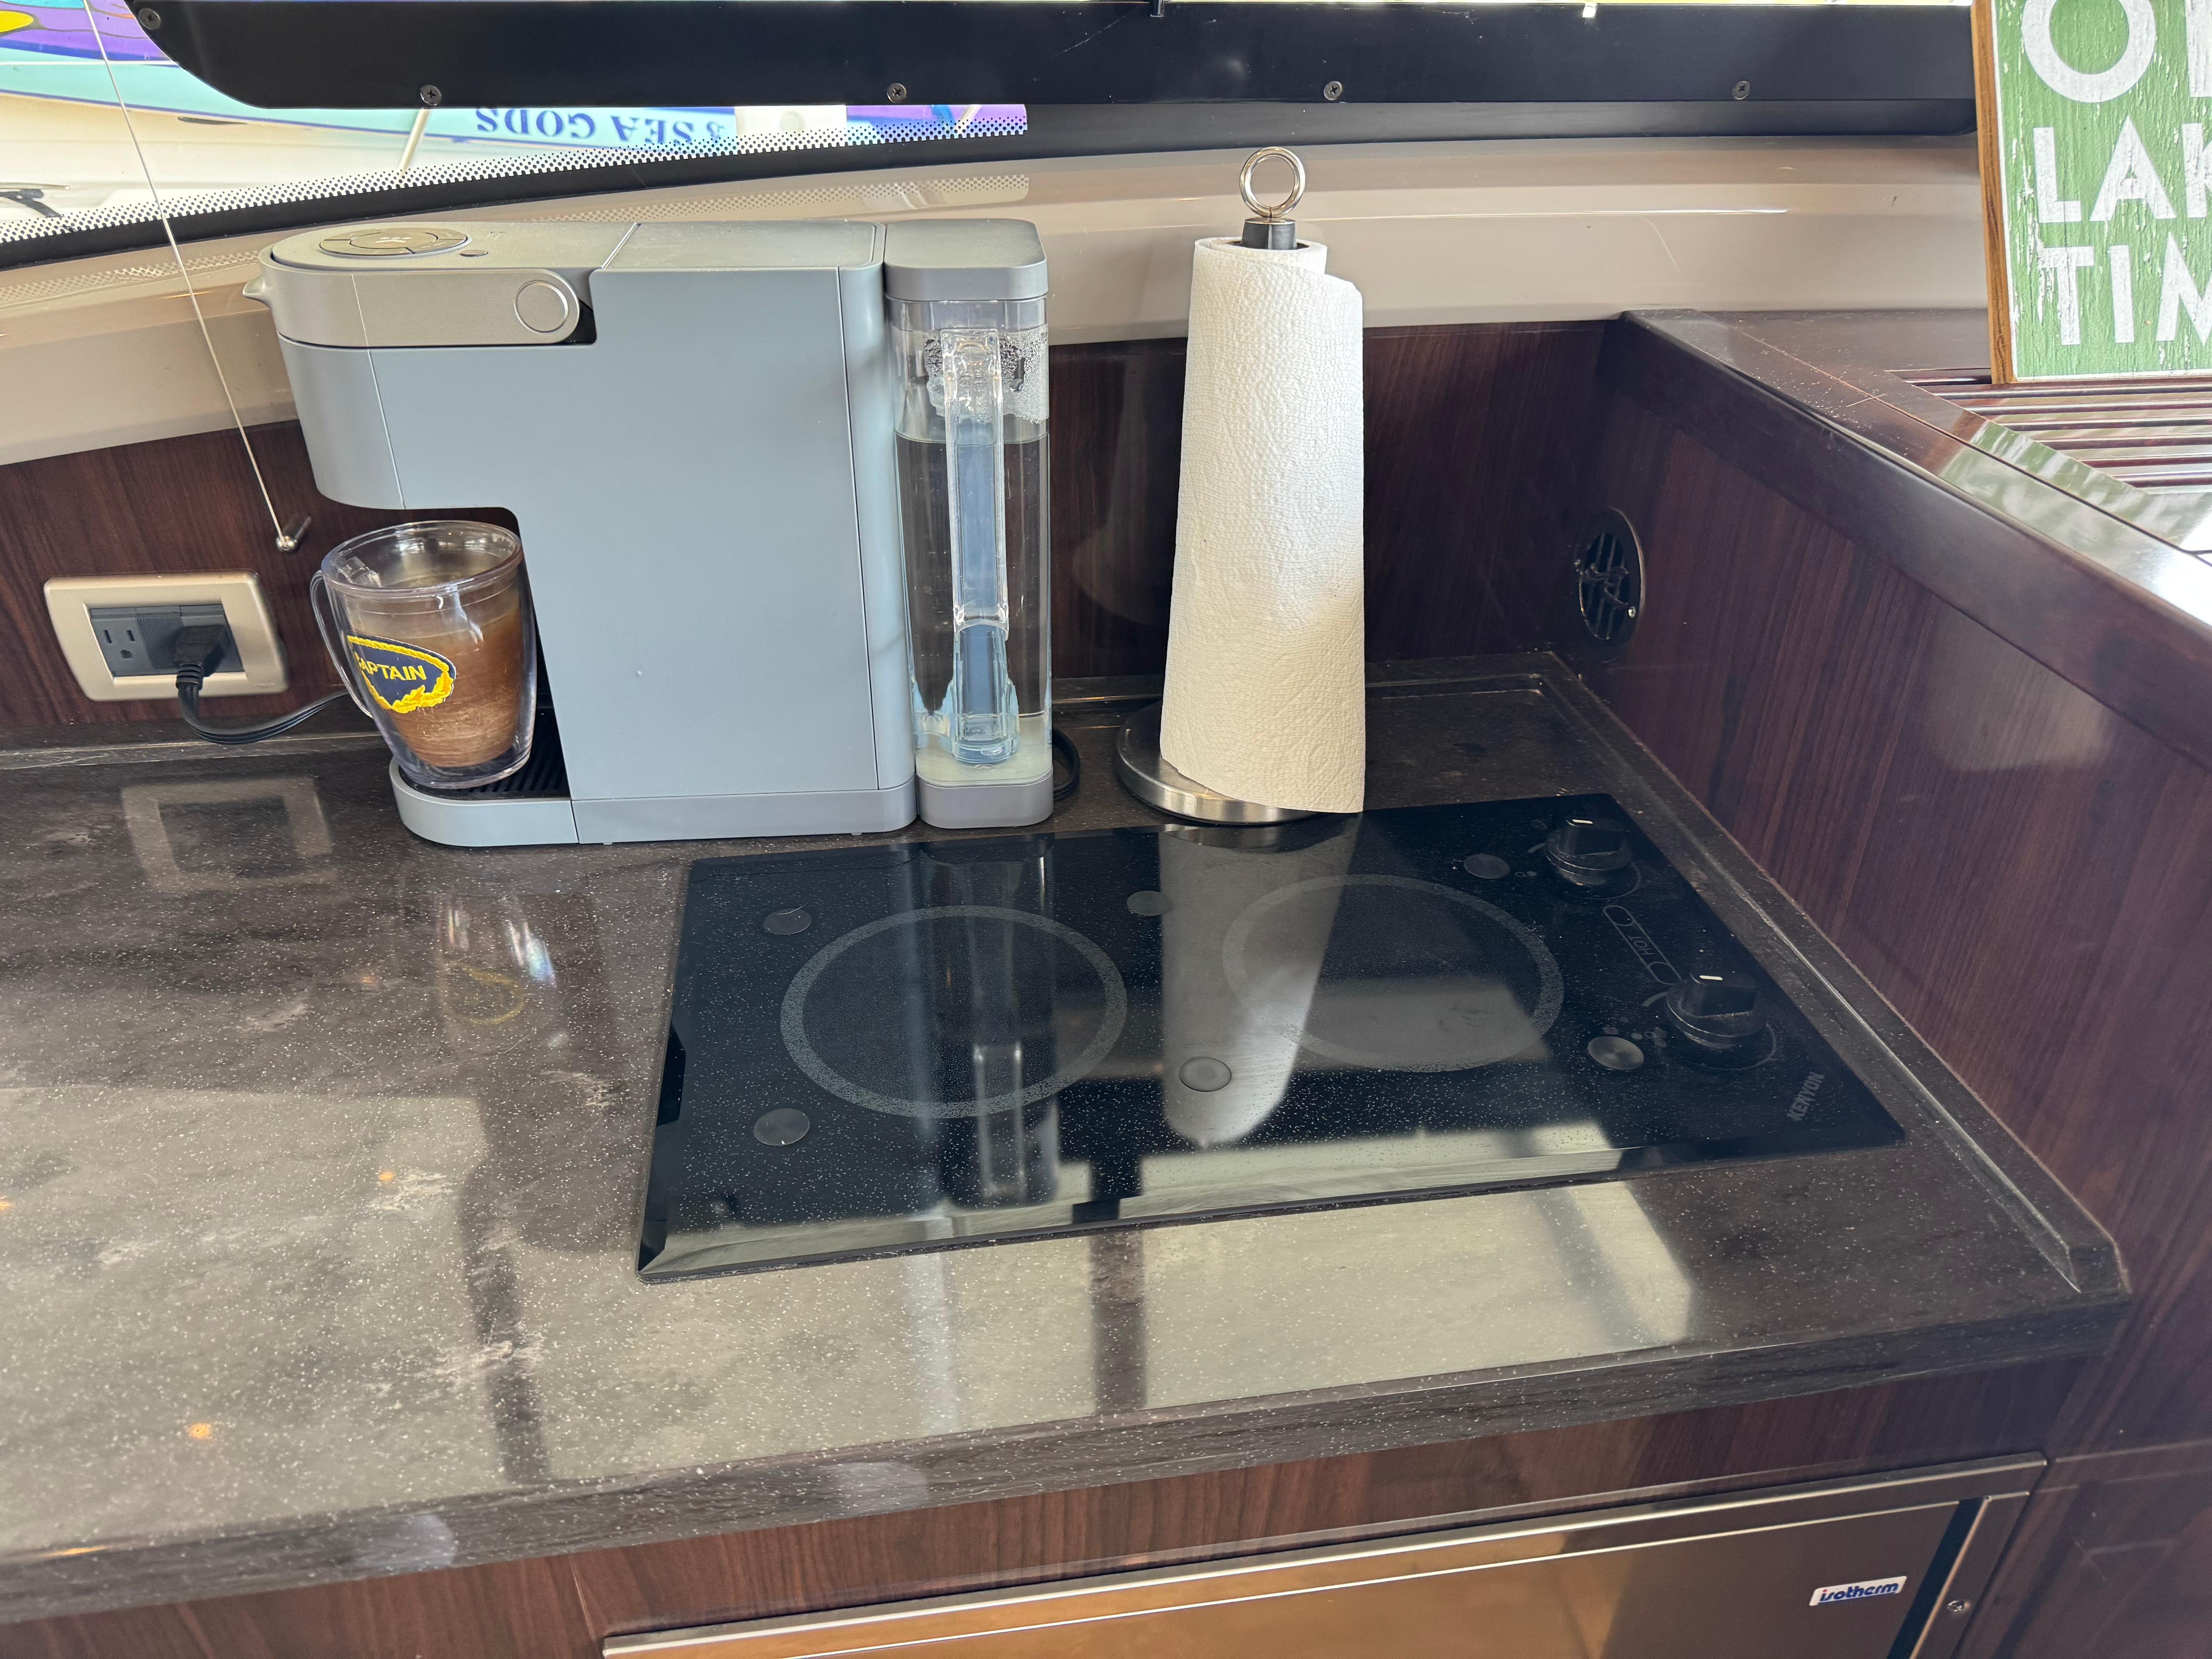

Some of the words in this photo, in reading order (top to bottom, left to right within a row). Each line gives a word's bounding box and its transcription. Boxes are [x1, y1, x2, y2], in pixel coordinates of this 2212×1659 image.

[2021, 0, 2212, 103] O
[476, 108, 596, 139] GODS
[609, 115, 694, 146] SEA
[1628, 935, 1655, 955] HOT
[1786, 1071, 1825, 1122] KENYON
[1820, 1582, 1899, 1602] isotherm
